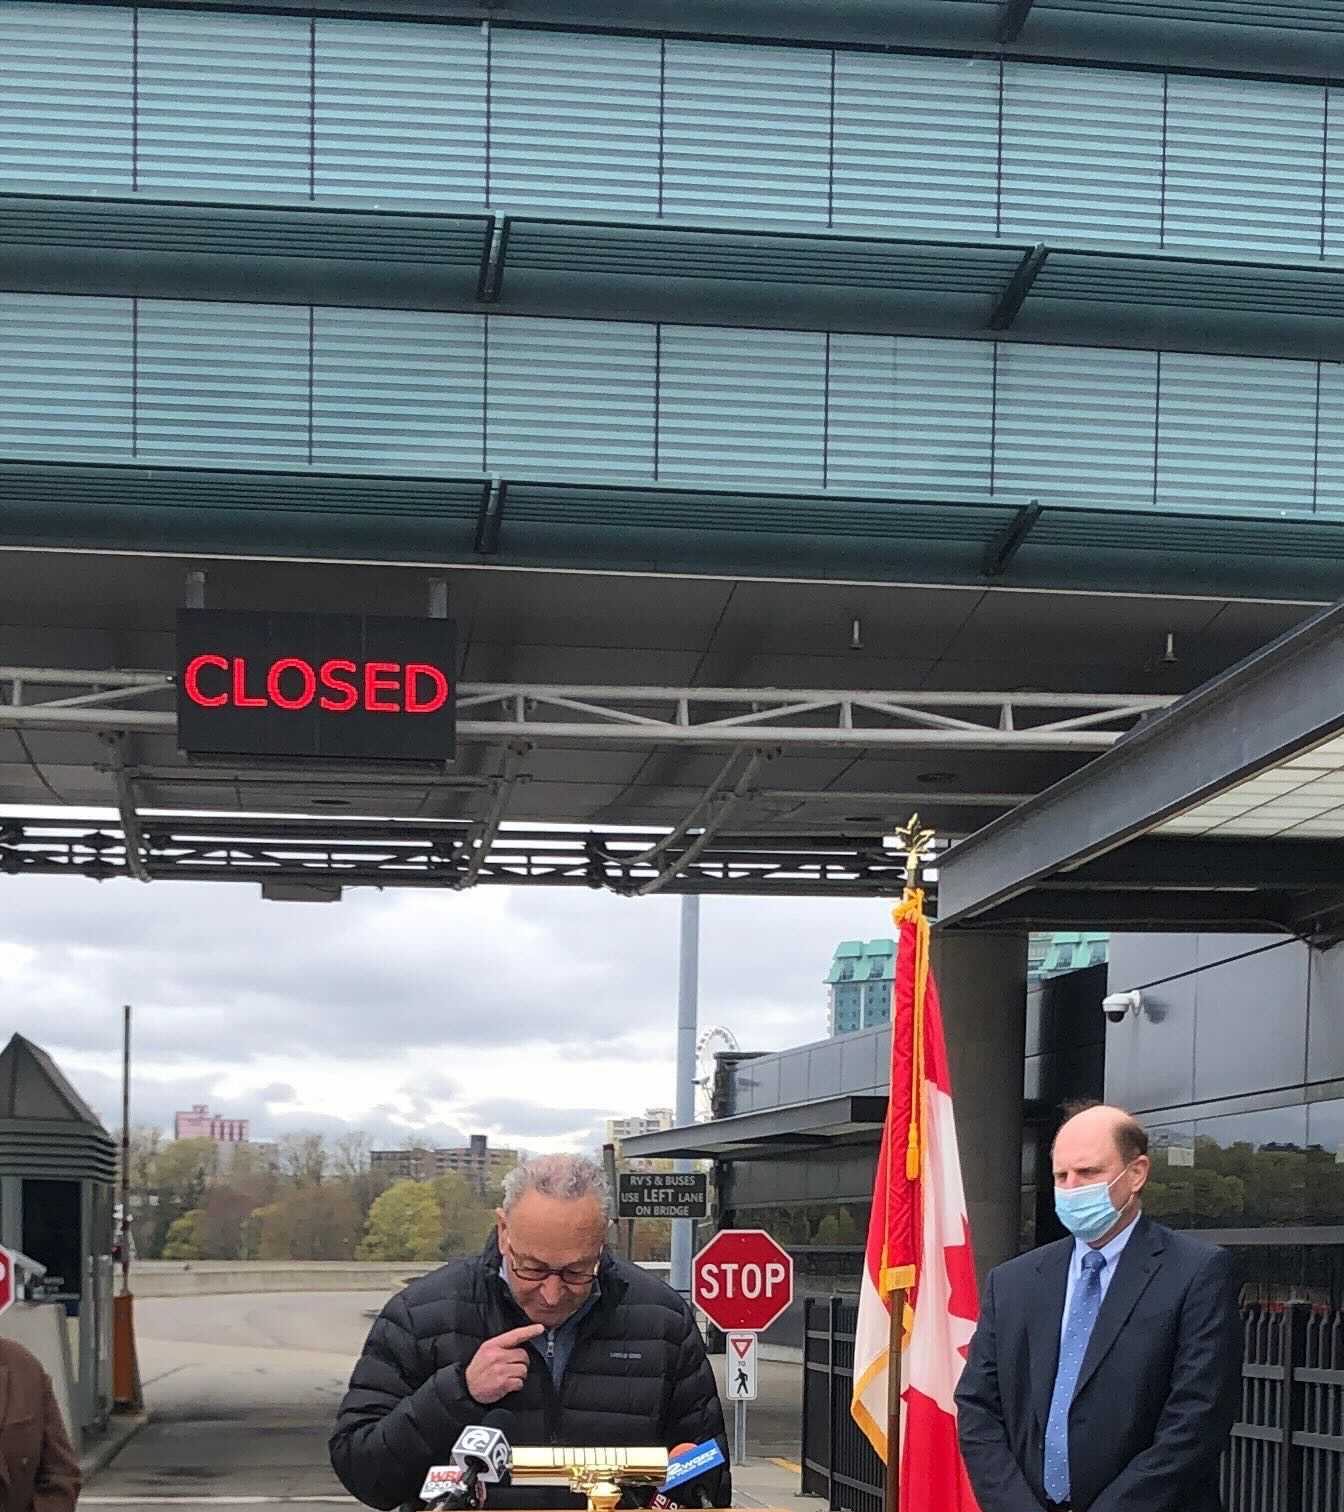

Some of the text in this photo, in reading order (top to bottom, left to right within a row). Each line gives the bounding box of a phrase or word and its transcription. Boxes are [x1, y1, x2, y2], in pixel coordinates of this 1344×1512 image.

[184, 654, 449, 713] CLOSED
[654, 1176, 664, 1186] &
[665, 1176, 696, 1186] BUSES
[621, 1188, 704, 1203] USE LEFT LANE
[635, 1206, 690, 1216] ON BRIDGE
[700, 1263, 785, 1299] STOP
